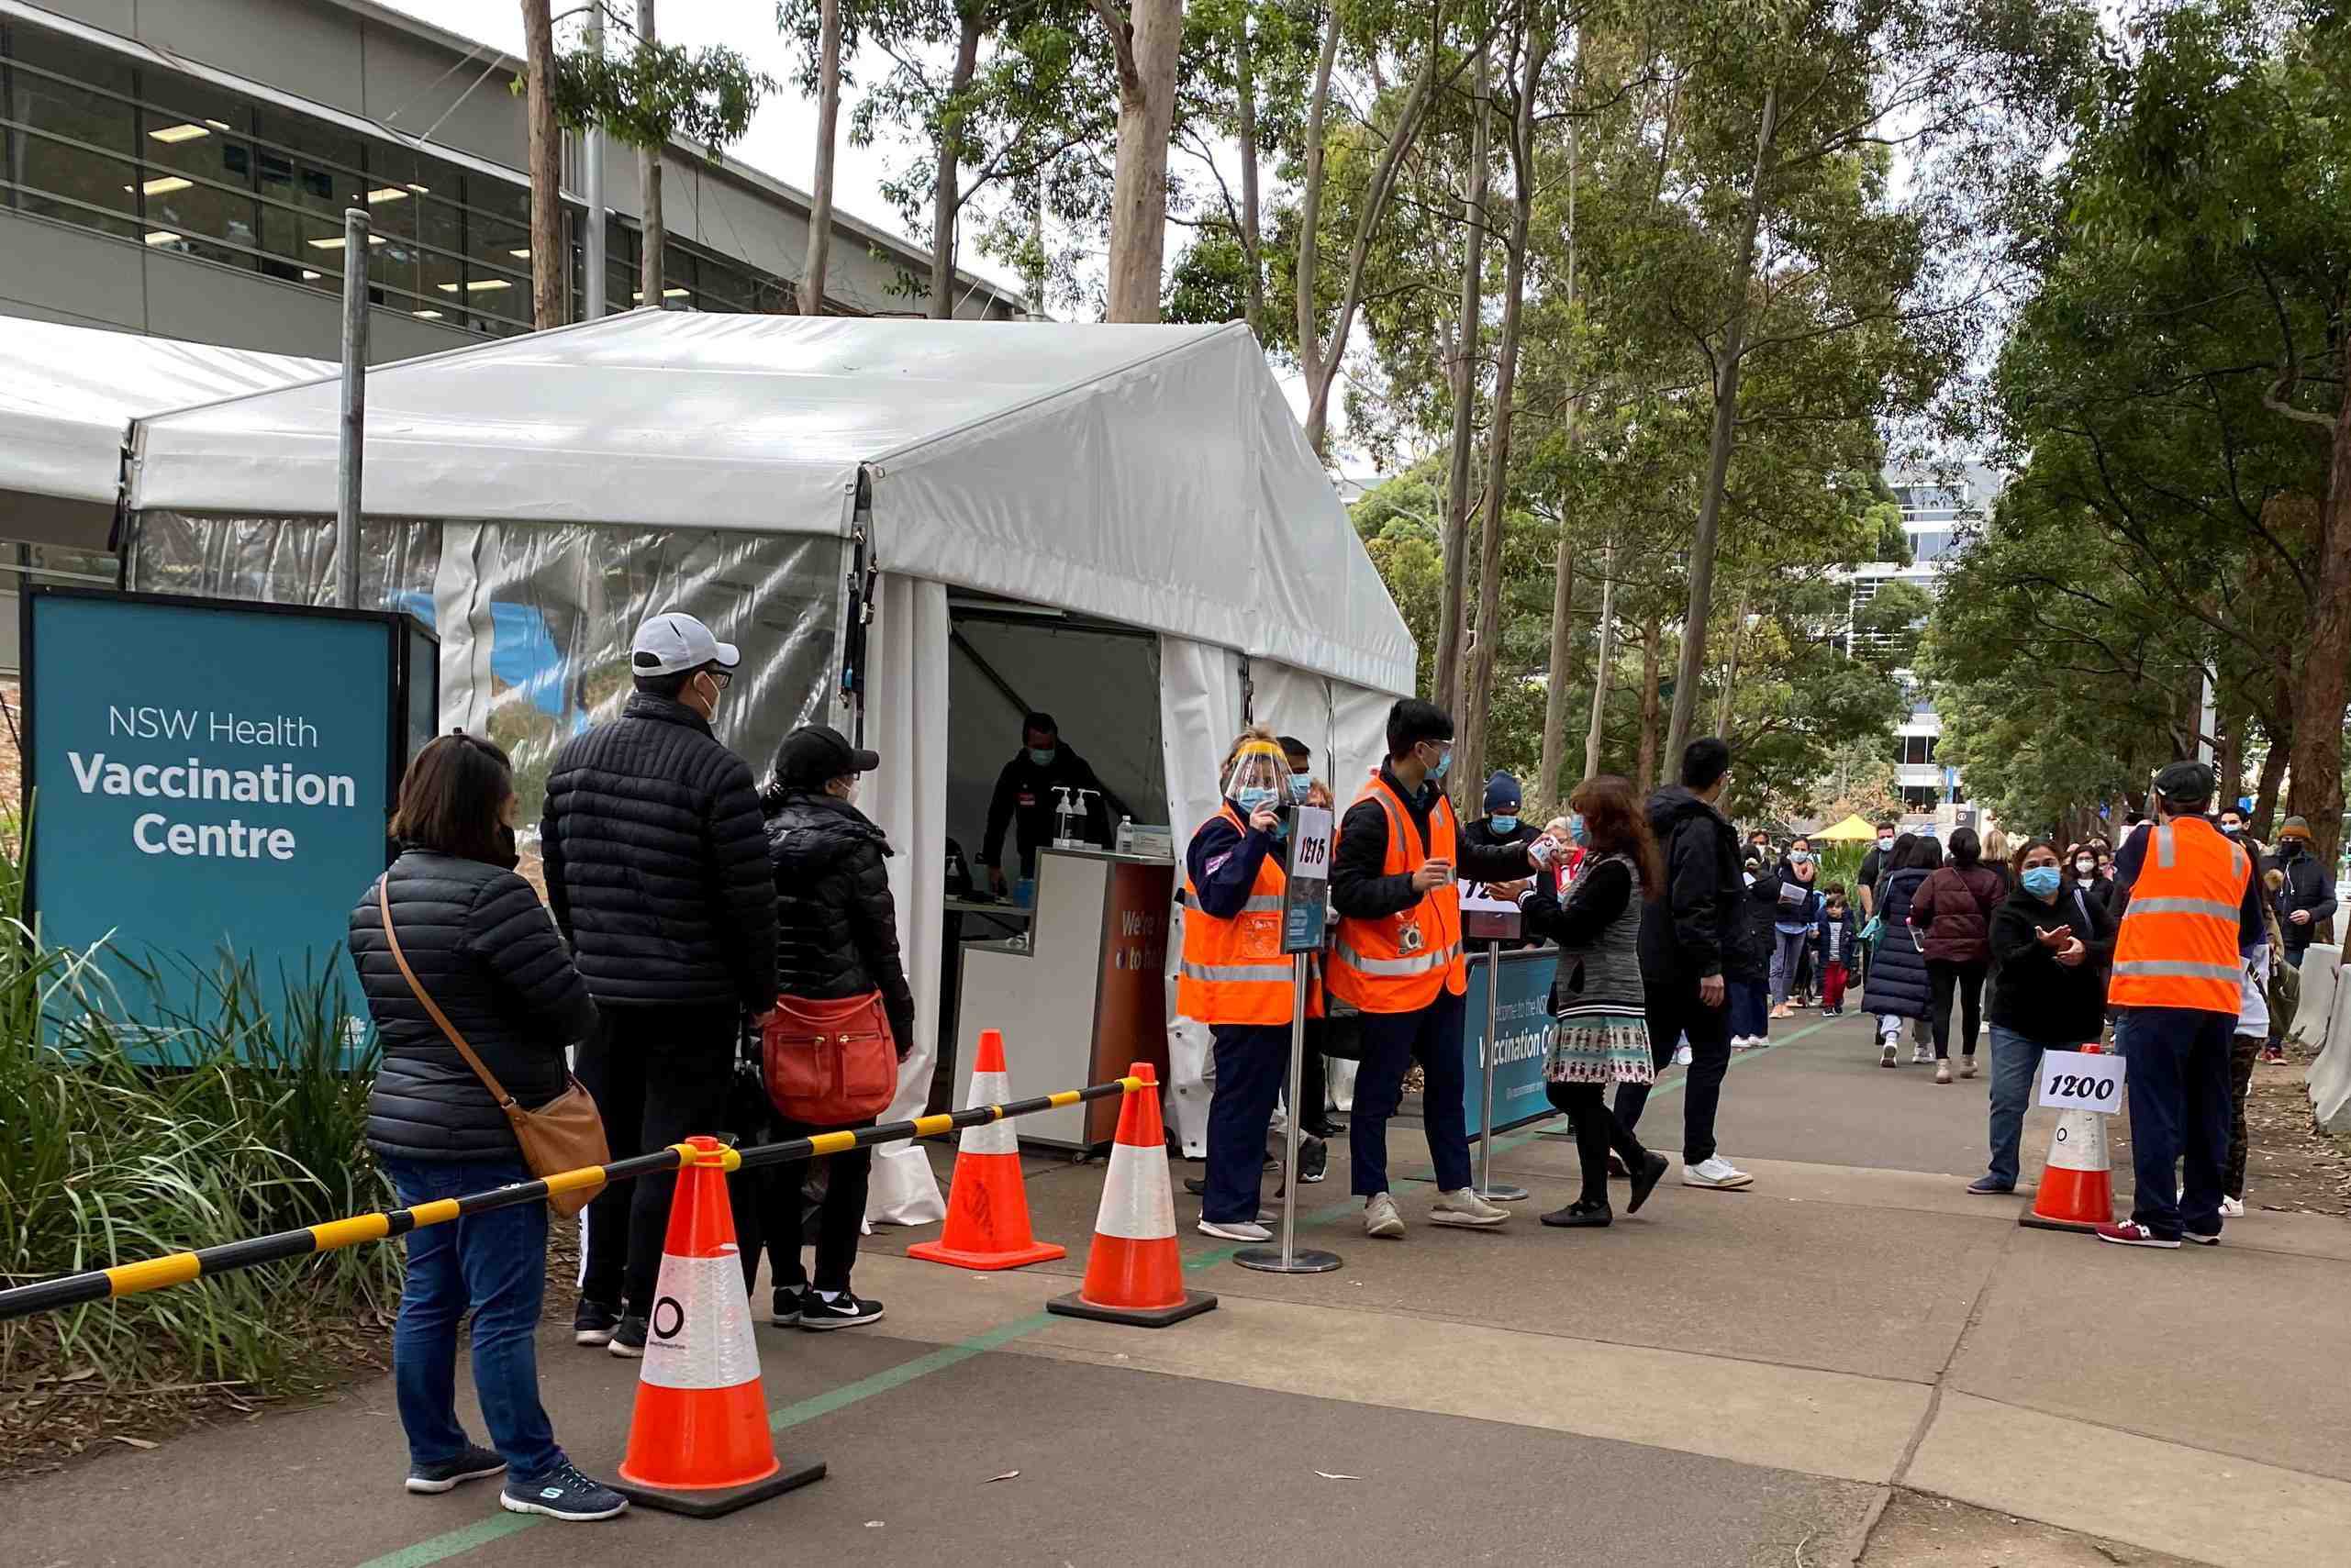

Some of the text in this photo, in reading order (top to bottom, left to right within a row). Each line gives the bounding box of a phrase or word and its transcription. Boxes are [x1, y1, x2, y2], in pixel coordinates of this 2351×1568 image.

[108, 705, 318, 749] NSW Health
[66, 751, 356, 807] Vaccination
[132, 812, 296, 861] Centre
[1130, 946, 1142, 971] to
[1478, 1027, 1541, 1069] Vccination
